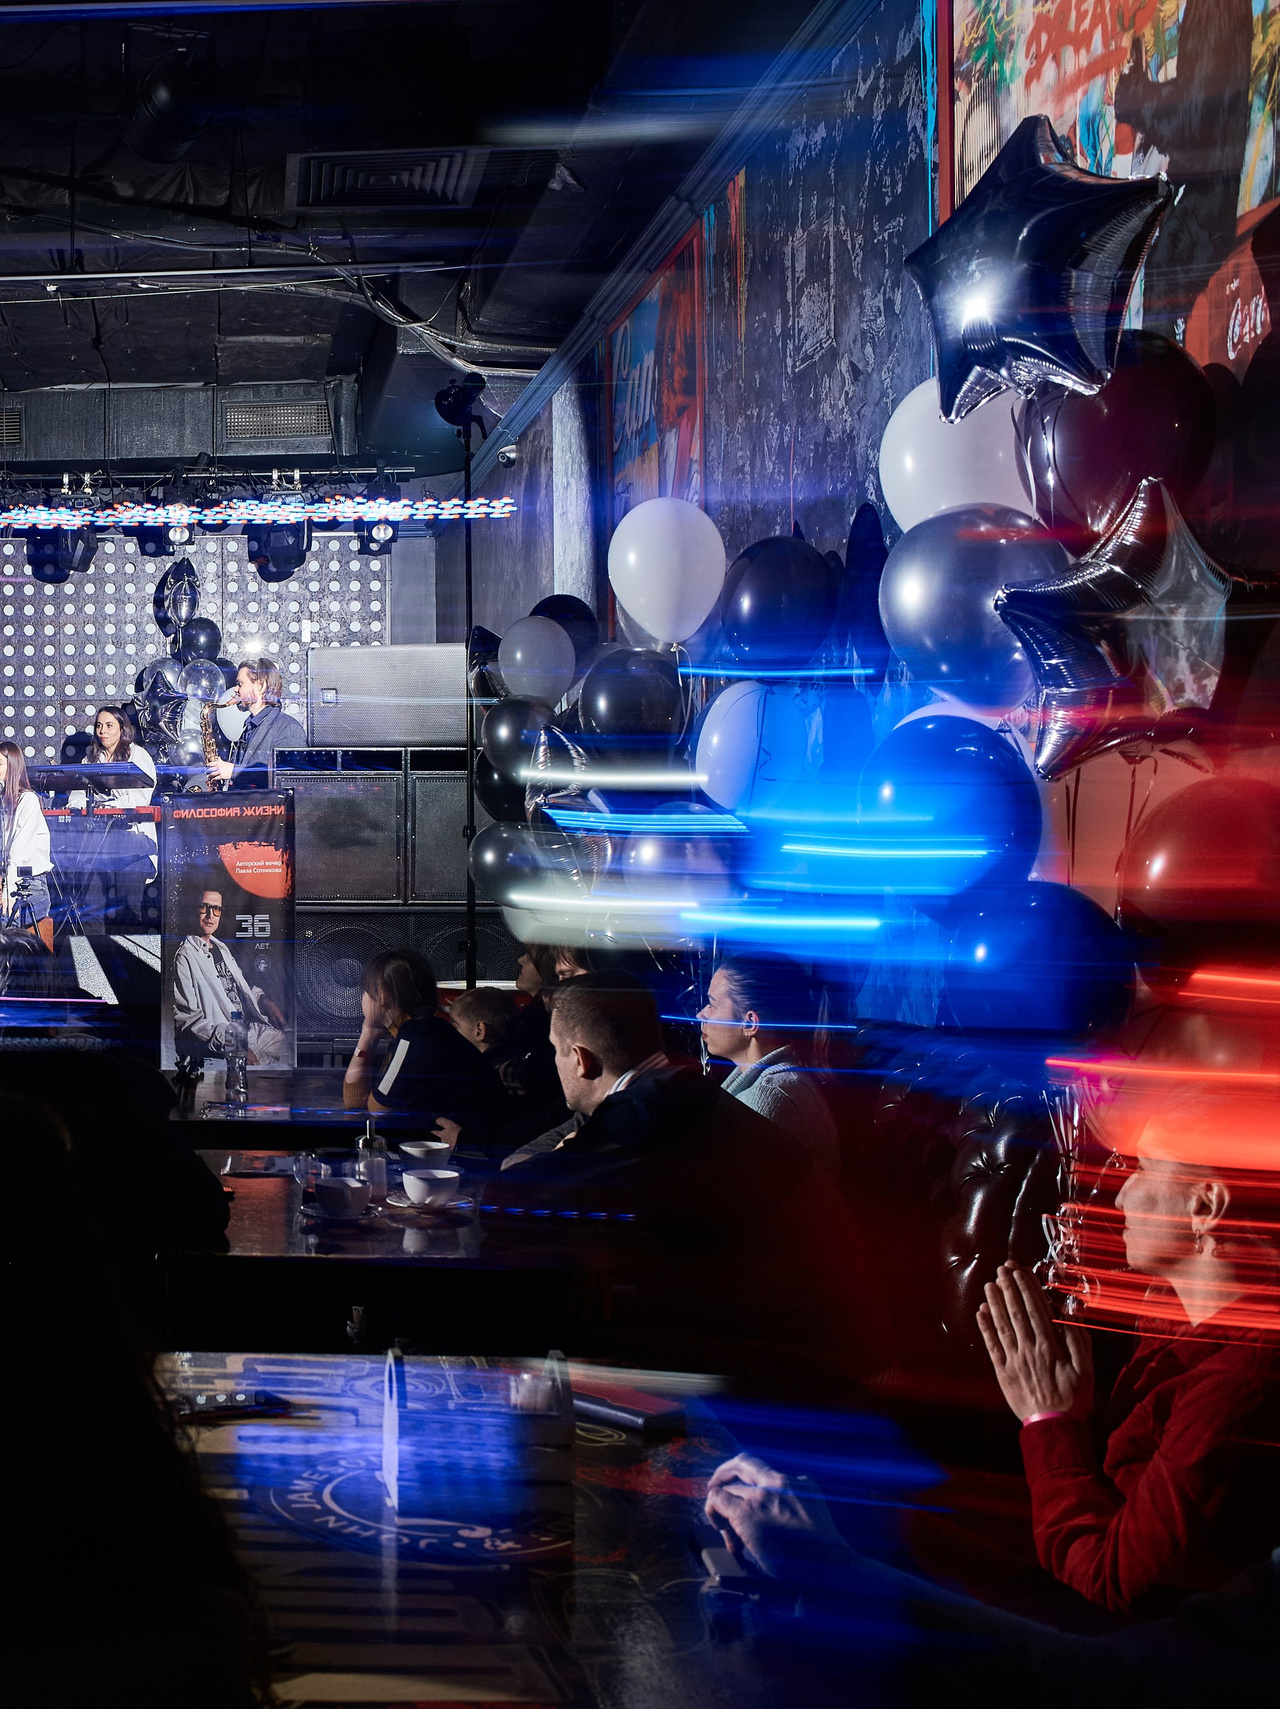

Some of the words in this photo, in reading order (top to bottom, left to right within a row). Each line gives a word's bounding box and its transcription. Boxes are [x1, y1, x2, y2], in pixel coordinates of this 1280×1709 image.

[173, 807, 240, 819] ФИЛОСОФИЯ
[242, 805, 285, 816] ЖИЗНИ
[235, 914, 271, 938] 36
